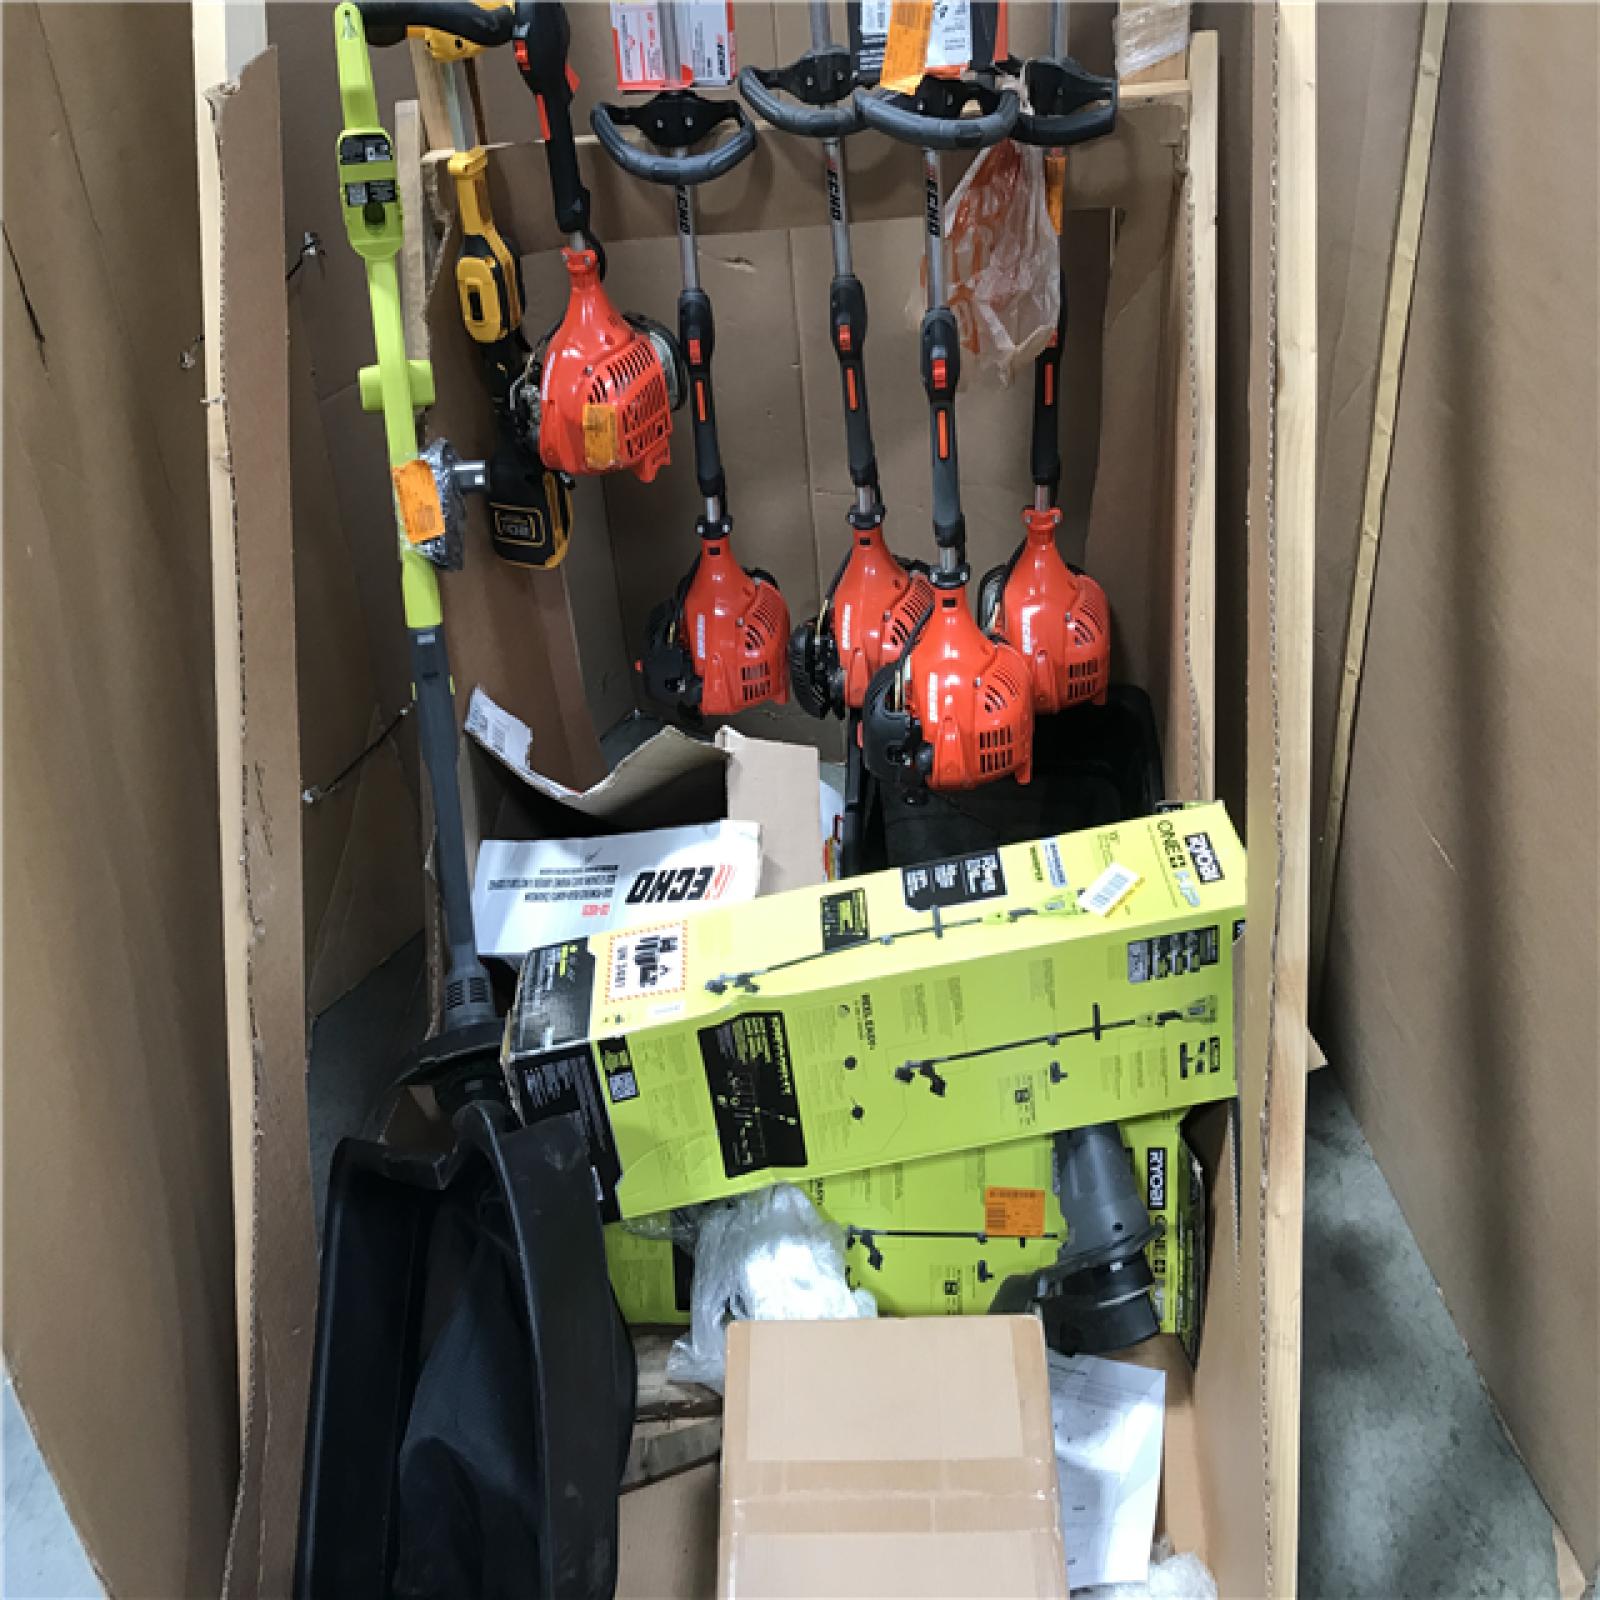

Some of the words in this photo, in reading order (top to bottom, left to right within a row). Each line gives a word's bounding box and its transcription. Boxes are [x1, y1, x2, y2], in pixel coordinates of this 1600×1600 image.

[827, 171, 842, 220] ECHO
[925, 179, 941, 238] ECHO
[1188, 833, 1221, 882] RYOBI
[625, 866, 716, 905] ECHO
[1149, 1149, 1164, 1209] RYOBI
